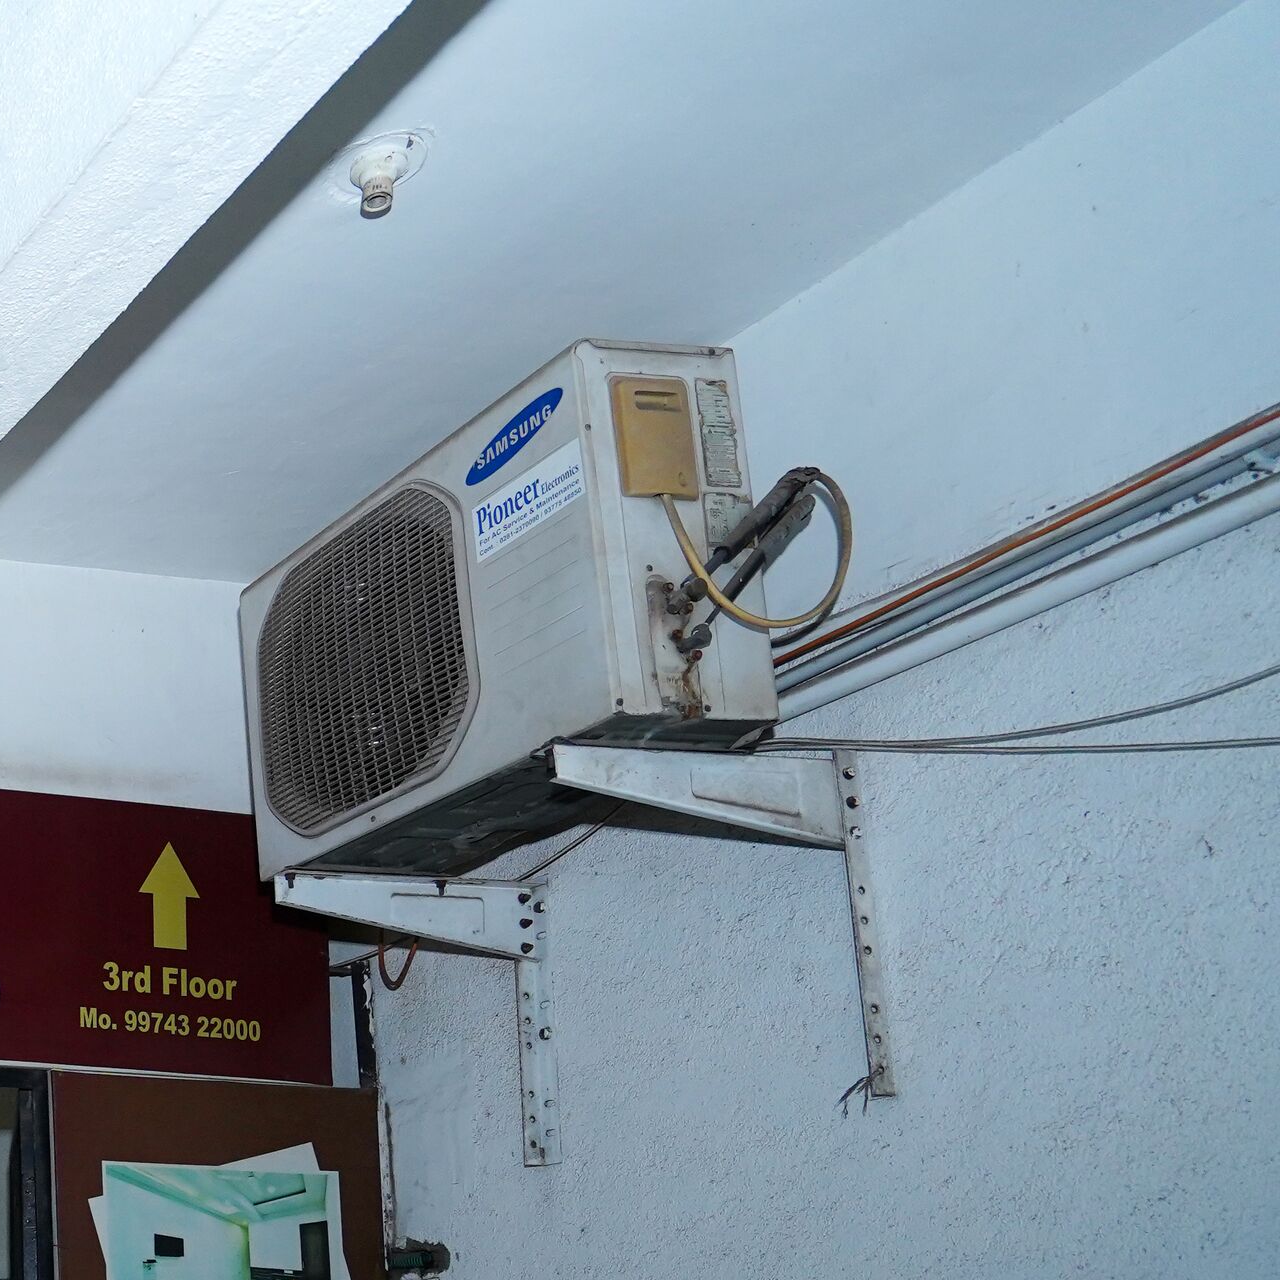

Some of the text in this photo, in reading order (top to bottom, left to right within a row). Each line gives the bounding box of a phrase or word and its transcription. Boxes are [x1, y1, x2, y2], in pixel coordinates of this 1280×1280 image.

[476, 404, 552, 469] SAMSUNG
[476, 464, 580, 536] Pioneer Electronics
[480, 535, 490, 546] For
[492, 528, 502, 538] AC
[503, 512, 528, 532] Service
[535, 478, 580, 510] Maintenance
[102, 961, 238, 1000] 3rd Floor
[79, 1006, 261, 1042] Mo. 99743 22000
